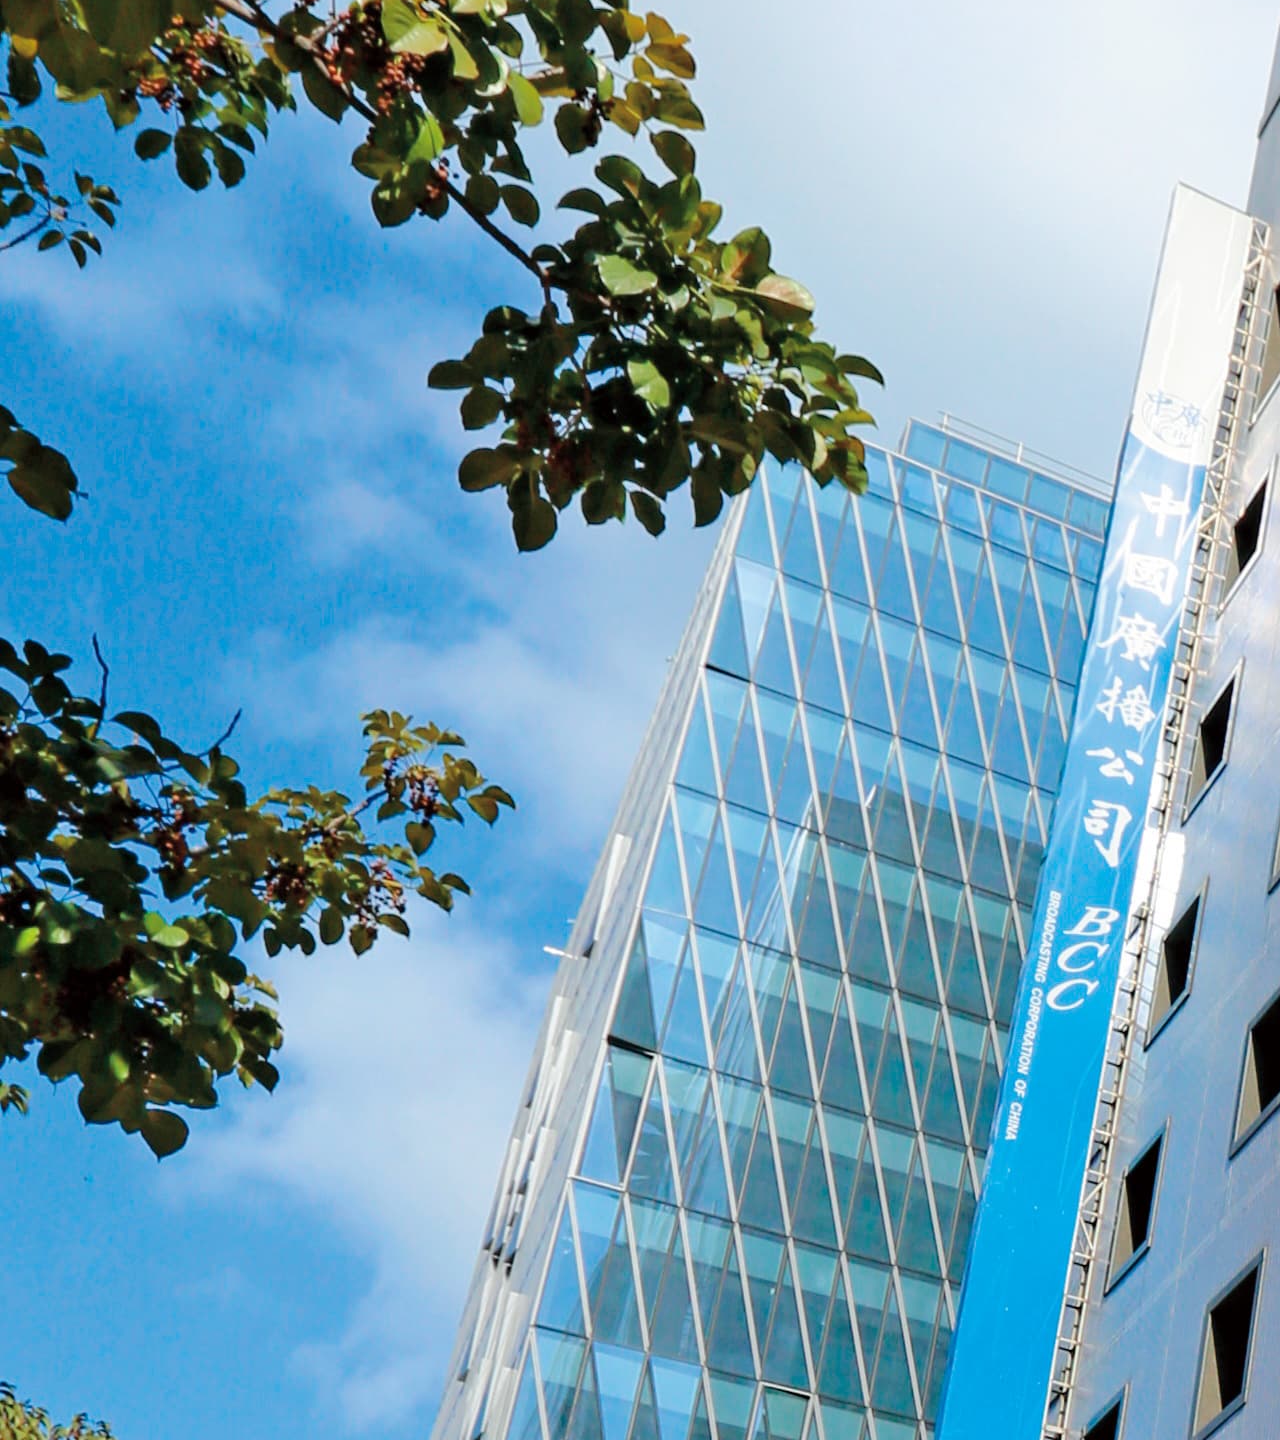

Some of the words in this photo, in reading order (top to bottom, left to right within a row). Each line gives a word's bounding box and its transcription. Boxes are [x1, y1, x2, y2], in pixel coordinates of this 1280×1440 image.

[1083, 483, 1191, 868] 中國廣播公司
[1033, 890, 1062, 984] BROADCASTING
[1046, 905, 1119, 1011] BCC
[1016, 987, 1044, 1076] CORPORATION
[1004, 1101, 1023, 1141] CHINA
[1013, 1081, 1028, 1098] OF
